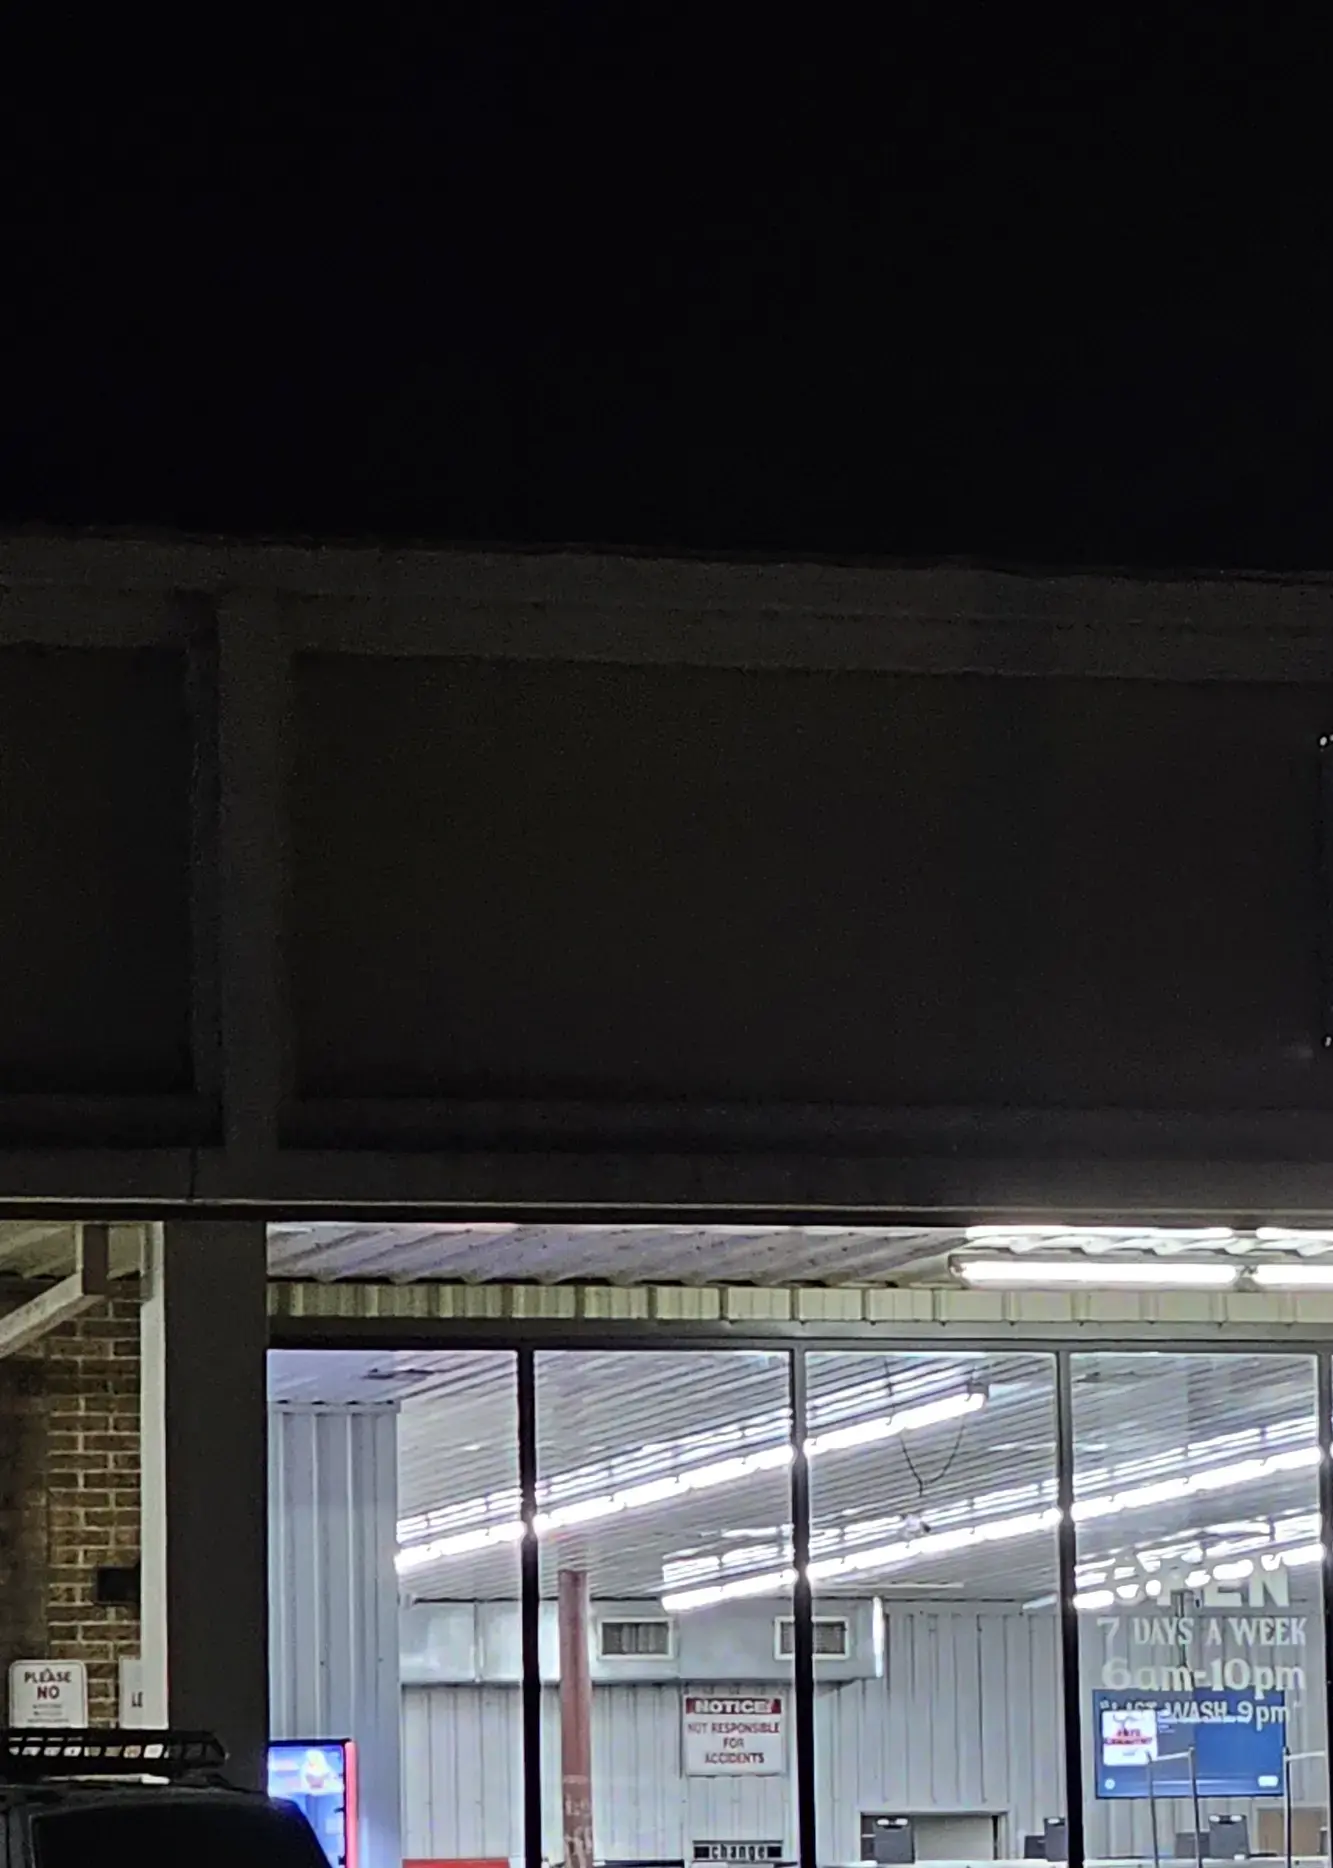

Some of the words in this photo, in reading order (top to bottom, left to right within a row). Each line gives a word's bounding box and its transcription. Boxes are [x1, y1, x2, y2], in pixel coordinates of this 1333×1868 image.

[1097, 1617, 1120, 1650] 7
[1133, 1617, 1194, 1645] DAYS
[1205, 1618, 1222, 1645] A
[1227, 1617, 1307, 1645] WEEK
[1101, 1657, 1306, 1700] 6am-10pm
[37, 1686, 60, 1700] NO
[711, 1722, 780, 1733] RESPONSIBLE
